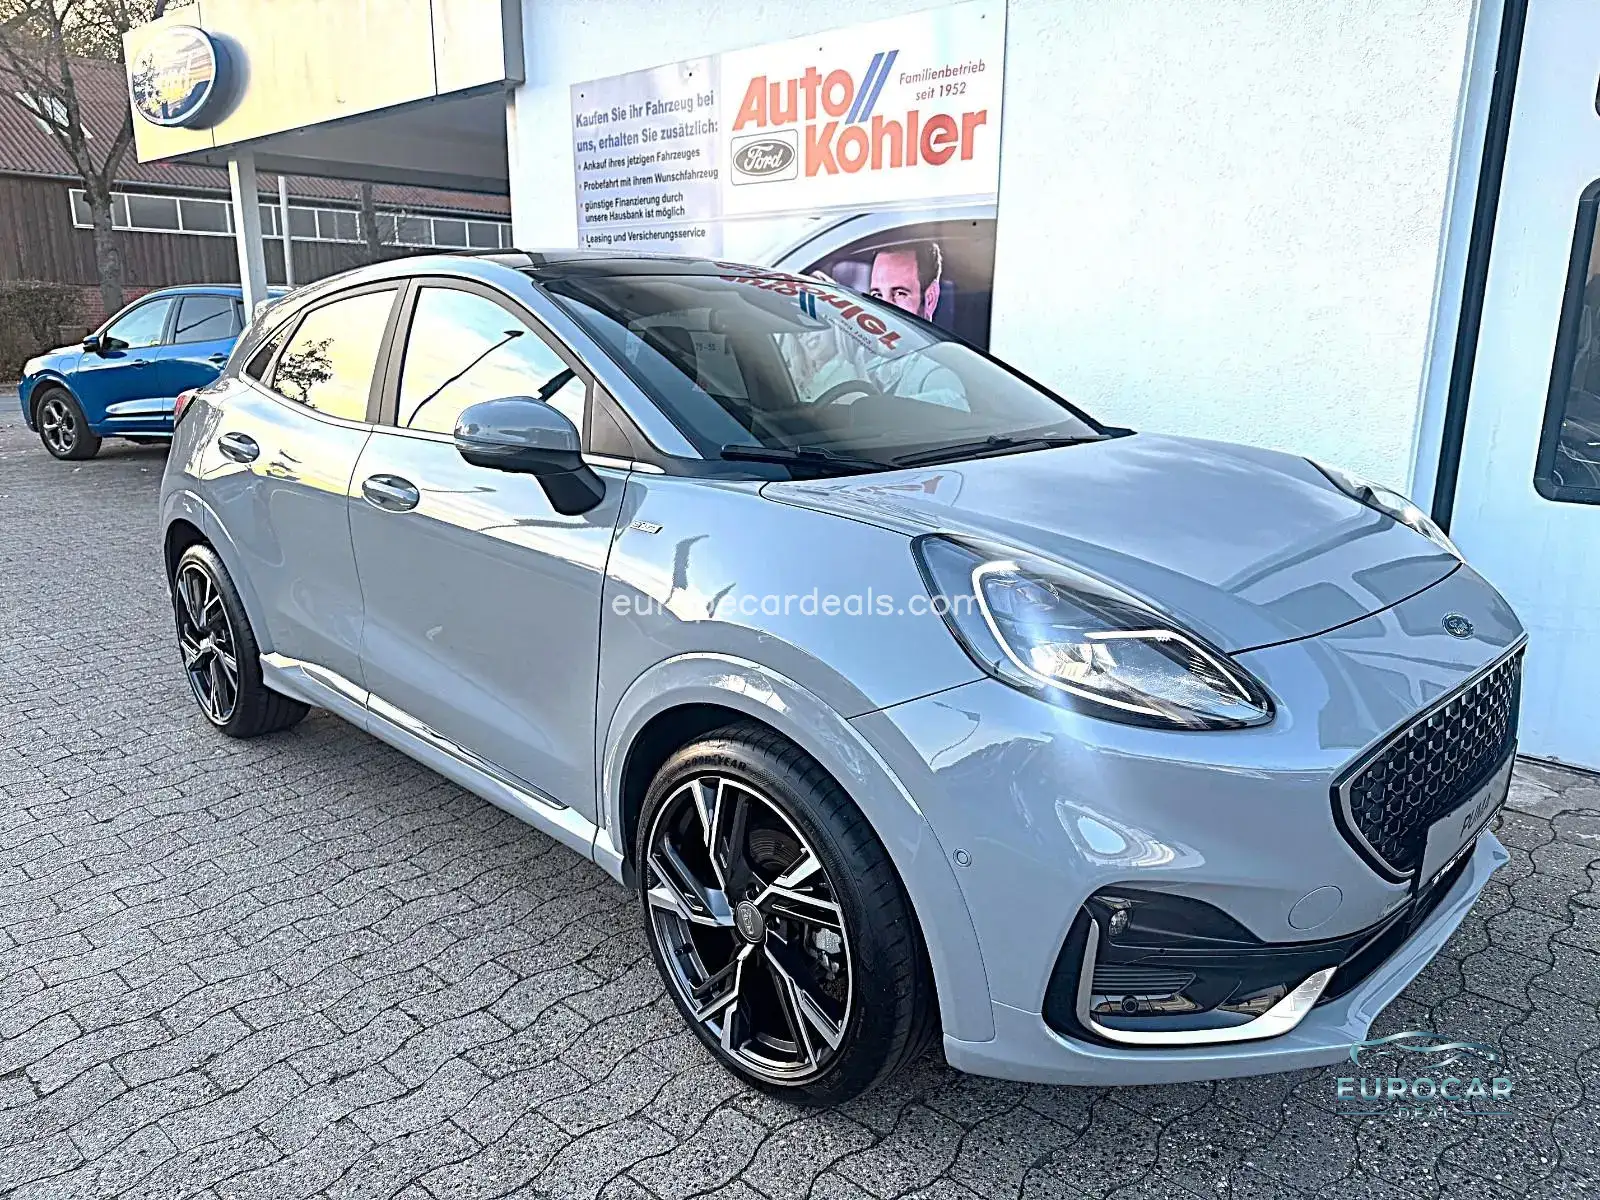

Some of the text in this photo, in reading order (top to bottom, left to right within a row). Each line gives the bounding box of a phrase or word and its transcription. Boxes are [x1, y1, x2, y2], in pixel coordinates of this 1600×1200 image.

[899, 59, 986, 85] Familienbetrieb
[731, 66, 855, 131] Auto
[915, 82, 967, 101] seit 1952
[575, 90, 714, 128] Kaufen Sie ihr Fahrzeug bei
[577, 119, 718, 153] uns, erhalten Sie zusätzlich:
[583, 148, 700, 171] Ankauf ihres jetzigen Fahrzeuges
[744, 144, 783, 170] Ford
[583, 168, 719, 191] Probefahrt mit ihrem Wunschfahrzeug
[584, 192, 684, 212] günstige Finanzierung durch
[585, 205, 686, 223] unsere Hausbank ist möglich
[586, 227, 706, 245] Leasing und Versicherungsservice
